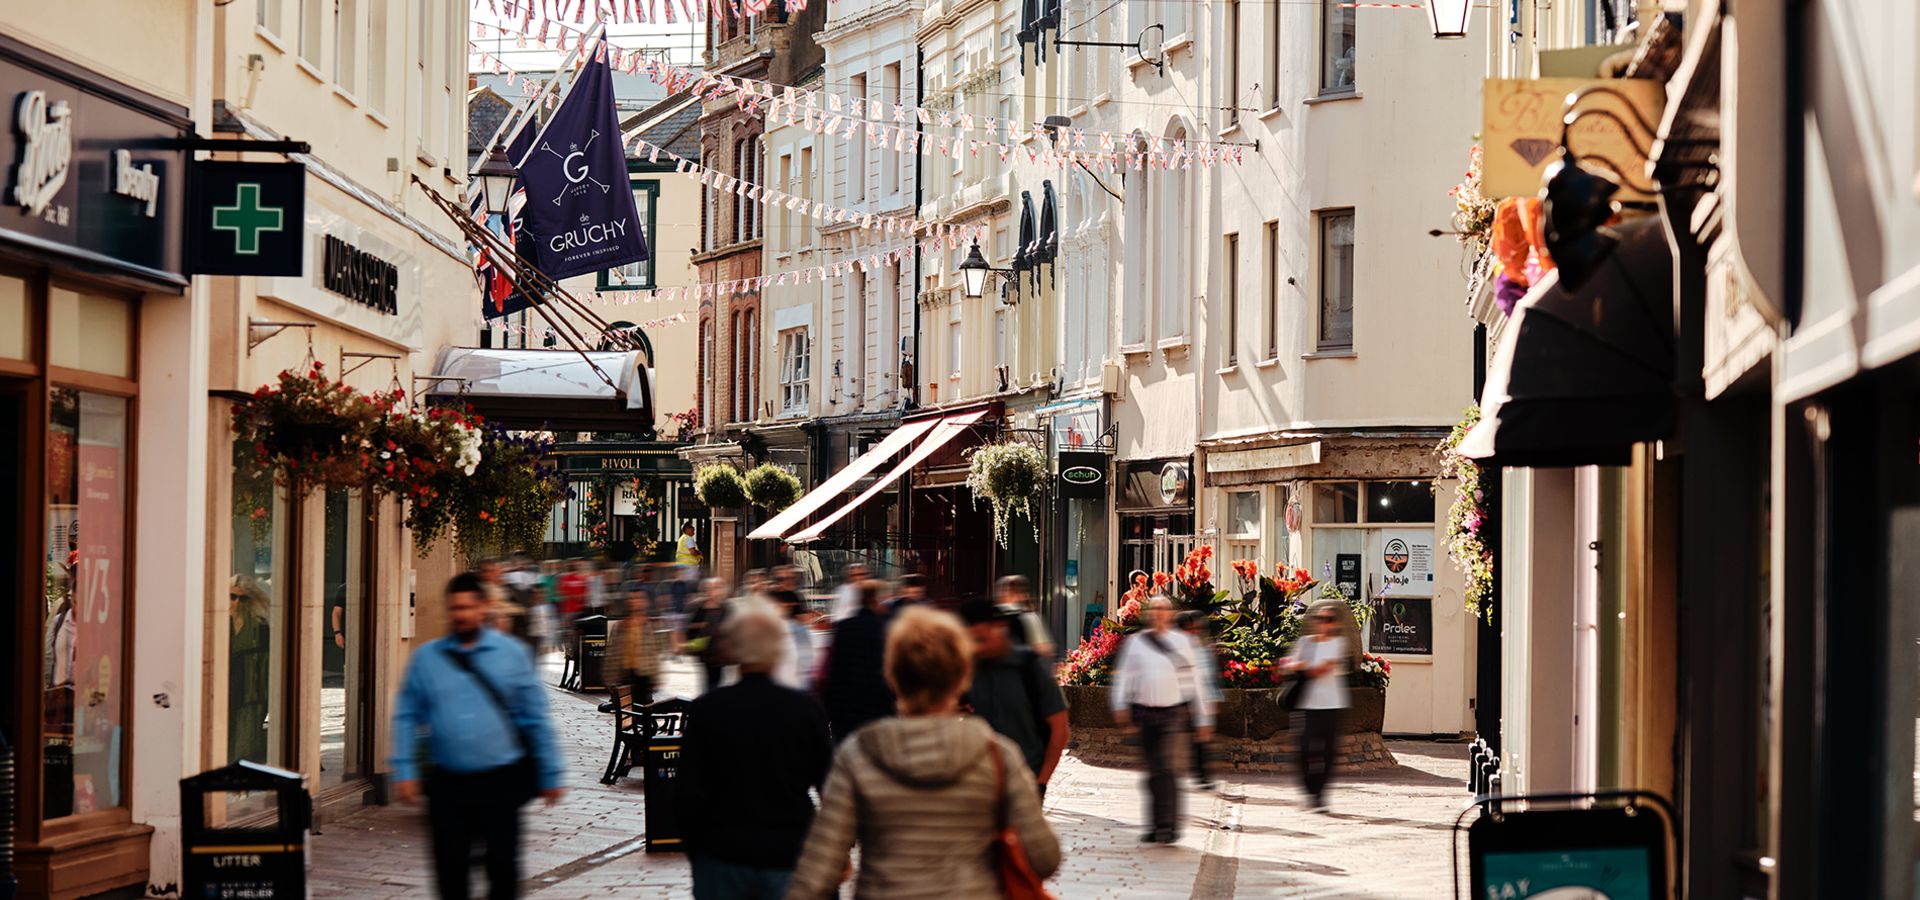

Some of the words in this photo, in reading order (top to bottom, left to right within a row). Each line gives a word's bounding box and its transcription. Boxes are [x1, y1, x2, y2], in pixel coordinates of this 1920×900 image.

[563, 151, 589, 183] G
[579, 213, 590, 222] de
[550, 218, 627, 252] GRUCHY
[564, 252, 591, 262] FOREVER
[592, 245, 620, 255] INSPIRED
[601, 458, 641, 469] RIVOLI
[1068, 470, 1096, 479] schuh
[1383, 623, 1416, 634] Prolec
[213, 855, 262, 868] LITTER
